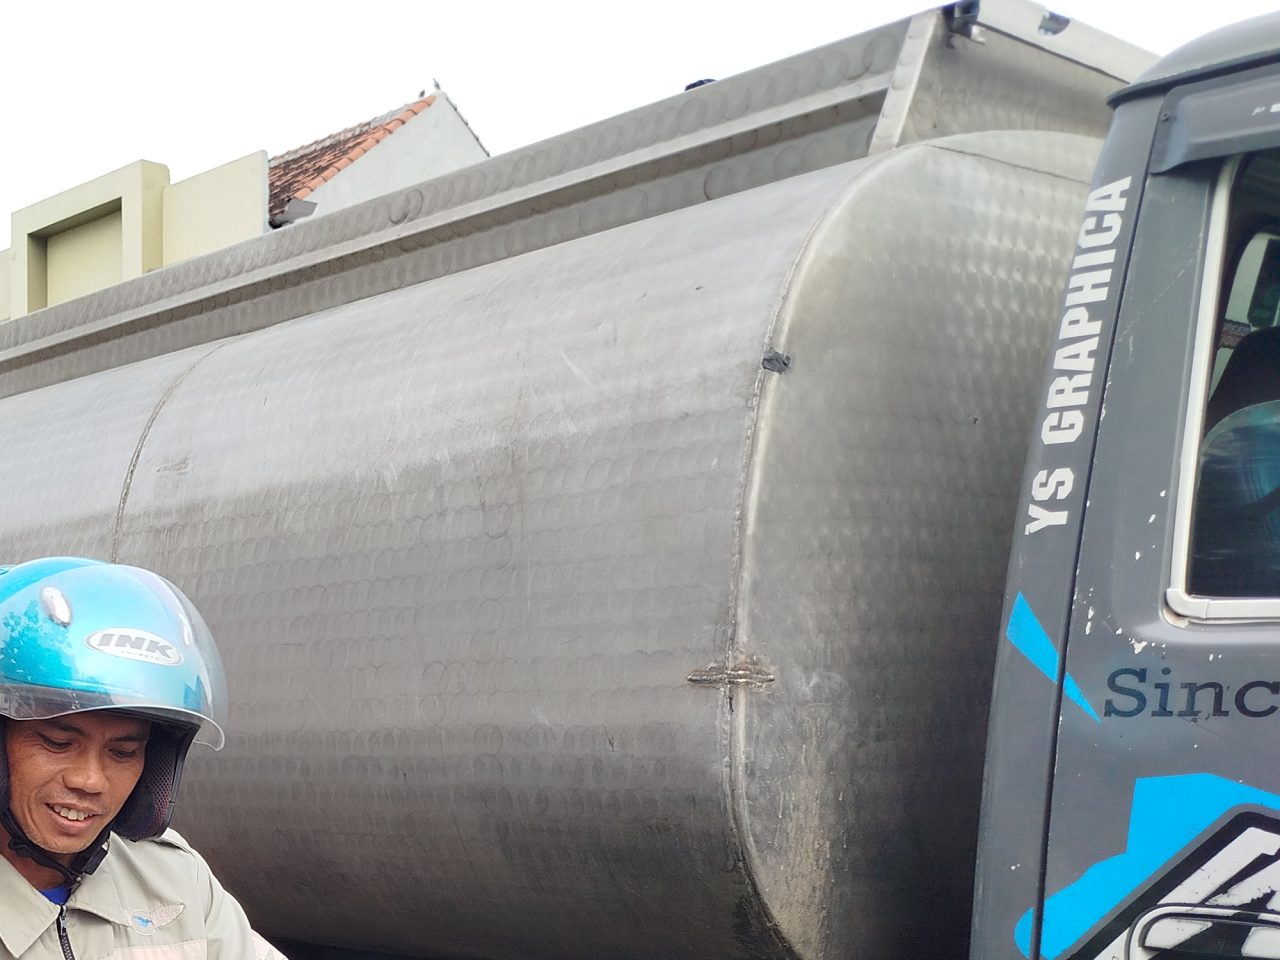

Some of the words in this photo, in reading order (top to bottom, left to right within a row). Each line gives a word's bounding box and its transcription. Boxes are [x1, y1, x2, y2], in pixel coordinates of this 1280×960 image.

[1040, 175, 1132, 445] GRAPHICA
[1024, 467, 1074, 536] YS
[97, 633, 175, 659] INK
